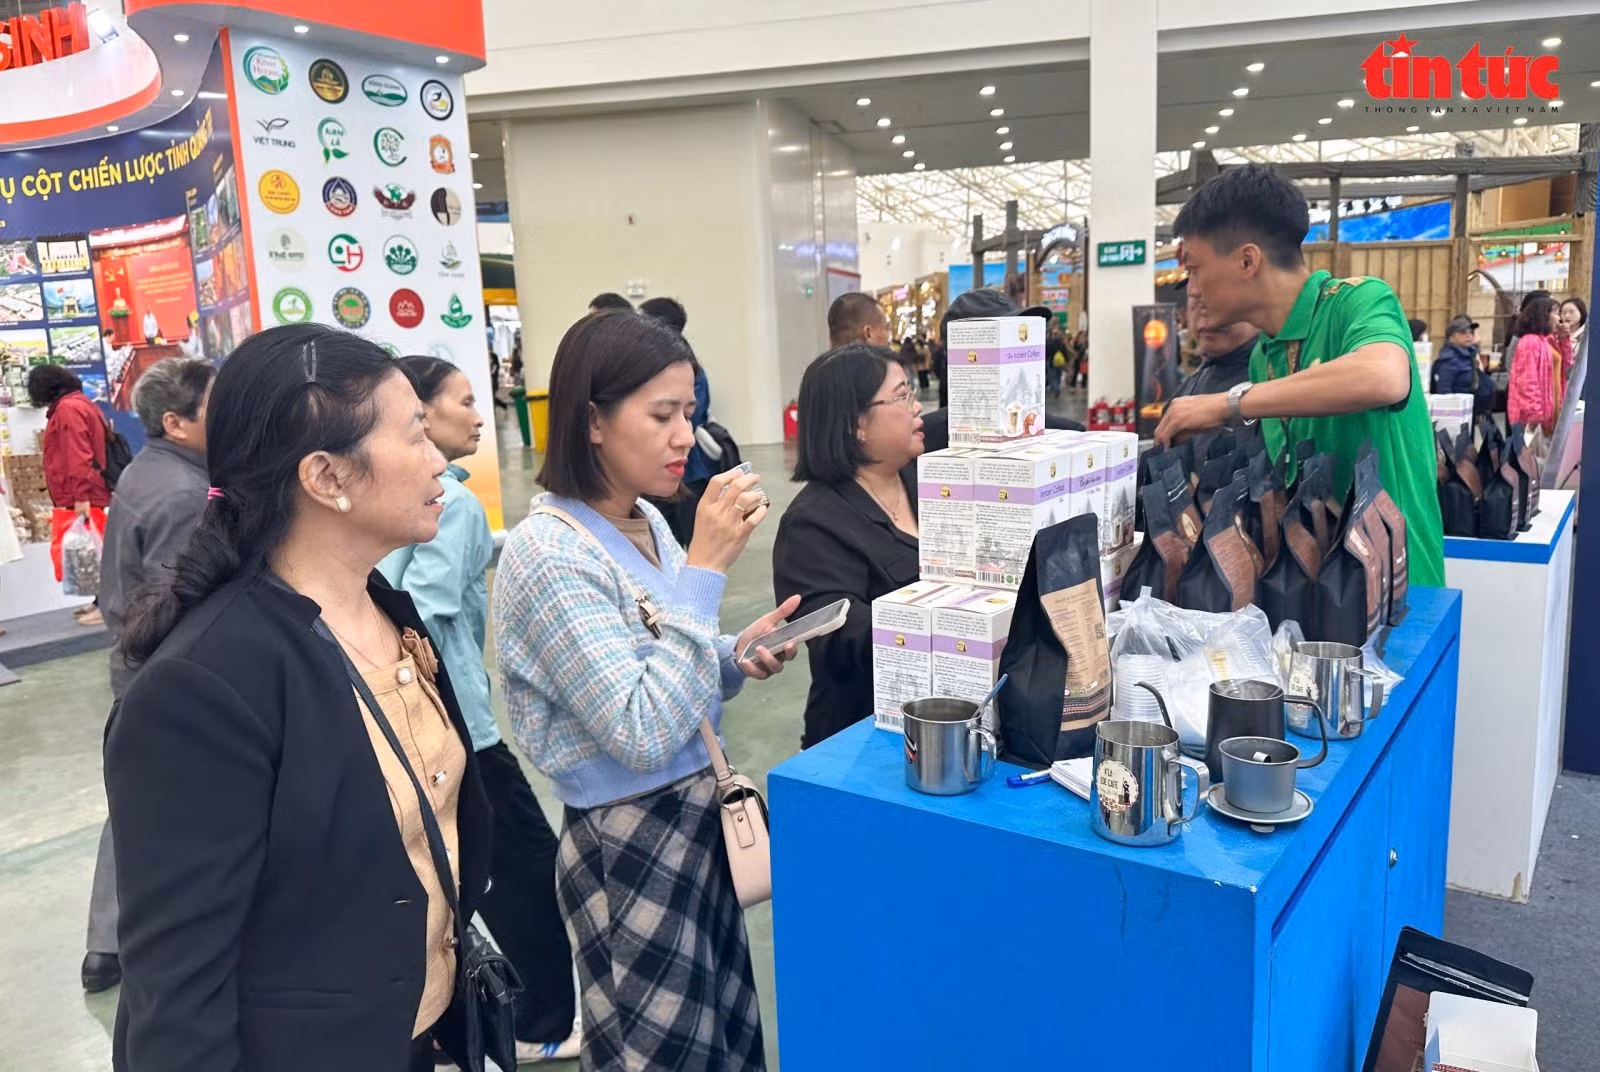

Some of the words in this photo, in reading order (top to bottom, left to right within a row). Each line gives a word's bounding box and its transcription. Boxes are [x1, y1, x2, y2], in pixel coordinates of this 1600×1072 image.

[21, 168, 63, 200] CỘT
[69, 156, 122, 191] CHIẾN
[125, 152, 165, 184] LƯỢC
[165, 139, 190, 171] TỈNH
